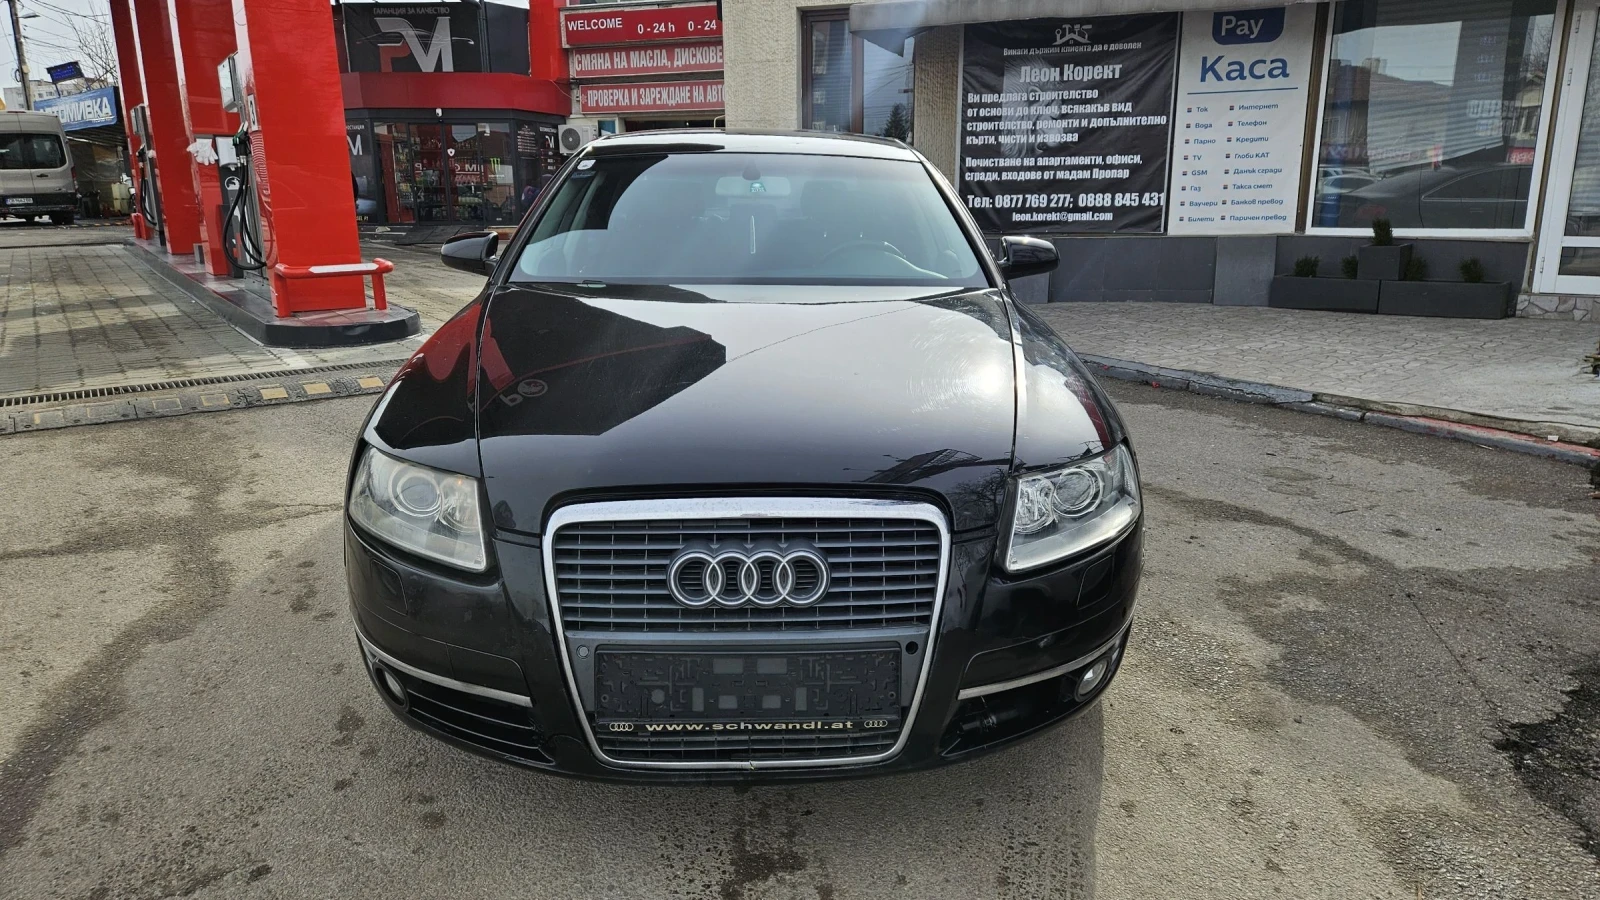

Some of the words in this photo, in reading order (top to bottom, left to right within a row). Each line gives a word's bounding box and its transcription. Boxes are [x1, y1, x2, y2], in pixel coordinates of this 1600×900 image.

[373, 7, 406, 15] ГАРАНЦИЯ
[416, 6, 450, 14] КАЧЕСТВО
[567, 18, 623, 31] WELCOME
[637, 24, 644, 34] 0
[653, 22, 666, 33] 24
[668, 22, 675, 32] h
[687, 21, 694, 32] 0
[704, 19, 717, 31] 24
[1221, 15, 1264, 39] Pay
[1004, 48, 1028, 56] Винаги
[1029, 46, 1060, 55] държим
[1061, 45, 1091, 53] клиента
[1092, 44, 1102, 52] да
[1109, 42, 1142, 51] доволен
[575, 52, 610, 71] СМЯНА
[614, 52, 628, 69] НА
[630, 49, 671, 68] МАСЛА,
[673, 45, 723, 68] ДИСКОВЕ
[1020, 66, 1060, 83] Леон
[1063, 64, 1122, 81] Корект
[1200, 55, 1290, 82] Каса
[587, 88, 628, 107] ПРОВЕРКА
[631, 88, 638, 105] И
[640, 85, 690, 106] ЗАРЕЖДАНЕ
[692, 85, 704, 103] НА
[968, 92, 980, 102] Ви
[981, 91, 1028, 103] предлага
[1029, 88, 1098, 102] строителство
[40, 97, 113, 124] ОМИВКА
[967, 108, 978, 117] от
[979, 106, 1014, 116] основи
[1017, 106, 1028, 117] до
[1030, 104, 1059, 117] ключ,
[1061, 102, 1110, 114] всякакъв
[1111, 102, 1133, 113] вид
[1238, 103, 1279, 111] Интернет
[966, 120, 1035, 132] строителство,
[1036, 119, 1080, 131] ремонти
[1081, 118, 1088, 127] и
[1090, 115, 1167, 128] допълнително
[1195, 122, 1212, 130] Вода
[1237, 119, 1267, 128] Телефон
[966, 134, 997, 146] кърти,
[998, 133, 1027, 143] чисти
[1028, 133, 1035, 142] и
[1037, 132, 1079, 142] извозва
[1193, 138, 1216, 146] Парно
[1236, 136, 1269, 144] Кредити
[965, 156, 1021, 167] Почистване
[1023, 156, 1035, 166] на
[1036, 154, 1104, 167] апартаменти,
[1106, 154, 1142, 166] офиси,
[1234, 152, 1254, 160] Глоби
[965, 170, 1000, 182] сгради,
[1001, 170, 1042, 181] входове
[1043, 170, 1054, 179] от
[1056, 168, 1091, 180] мадам
[1092, 168, 1130, 180] Пропар
[1233, 167, 1256, 175] Данък
[1258, 168, 1282, 176] сгради
[967, 195, 993, 208] Тел:
[995, 195, 1023, 208] 0877
[1025, 194, 1048, 207] 769
[1050, 194, 1074, 208] 277;
[1078, 193, 1112, 206] 0888
[1114, 192, 1140, 206] 845
[1142, 192, 1164, 206] 431
[1231, 198, 1256, 206] Банков
[1257, 198, 1283, 206] превод
[1012, 211, 1113, 222] leon.korekt@gmail.com
[1230, 214, 1260, 222] Паричен
[1261, 214, 1287, 222] превод
[645, 721, 854, 731] www.schwandl.at
